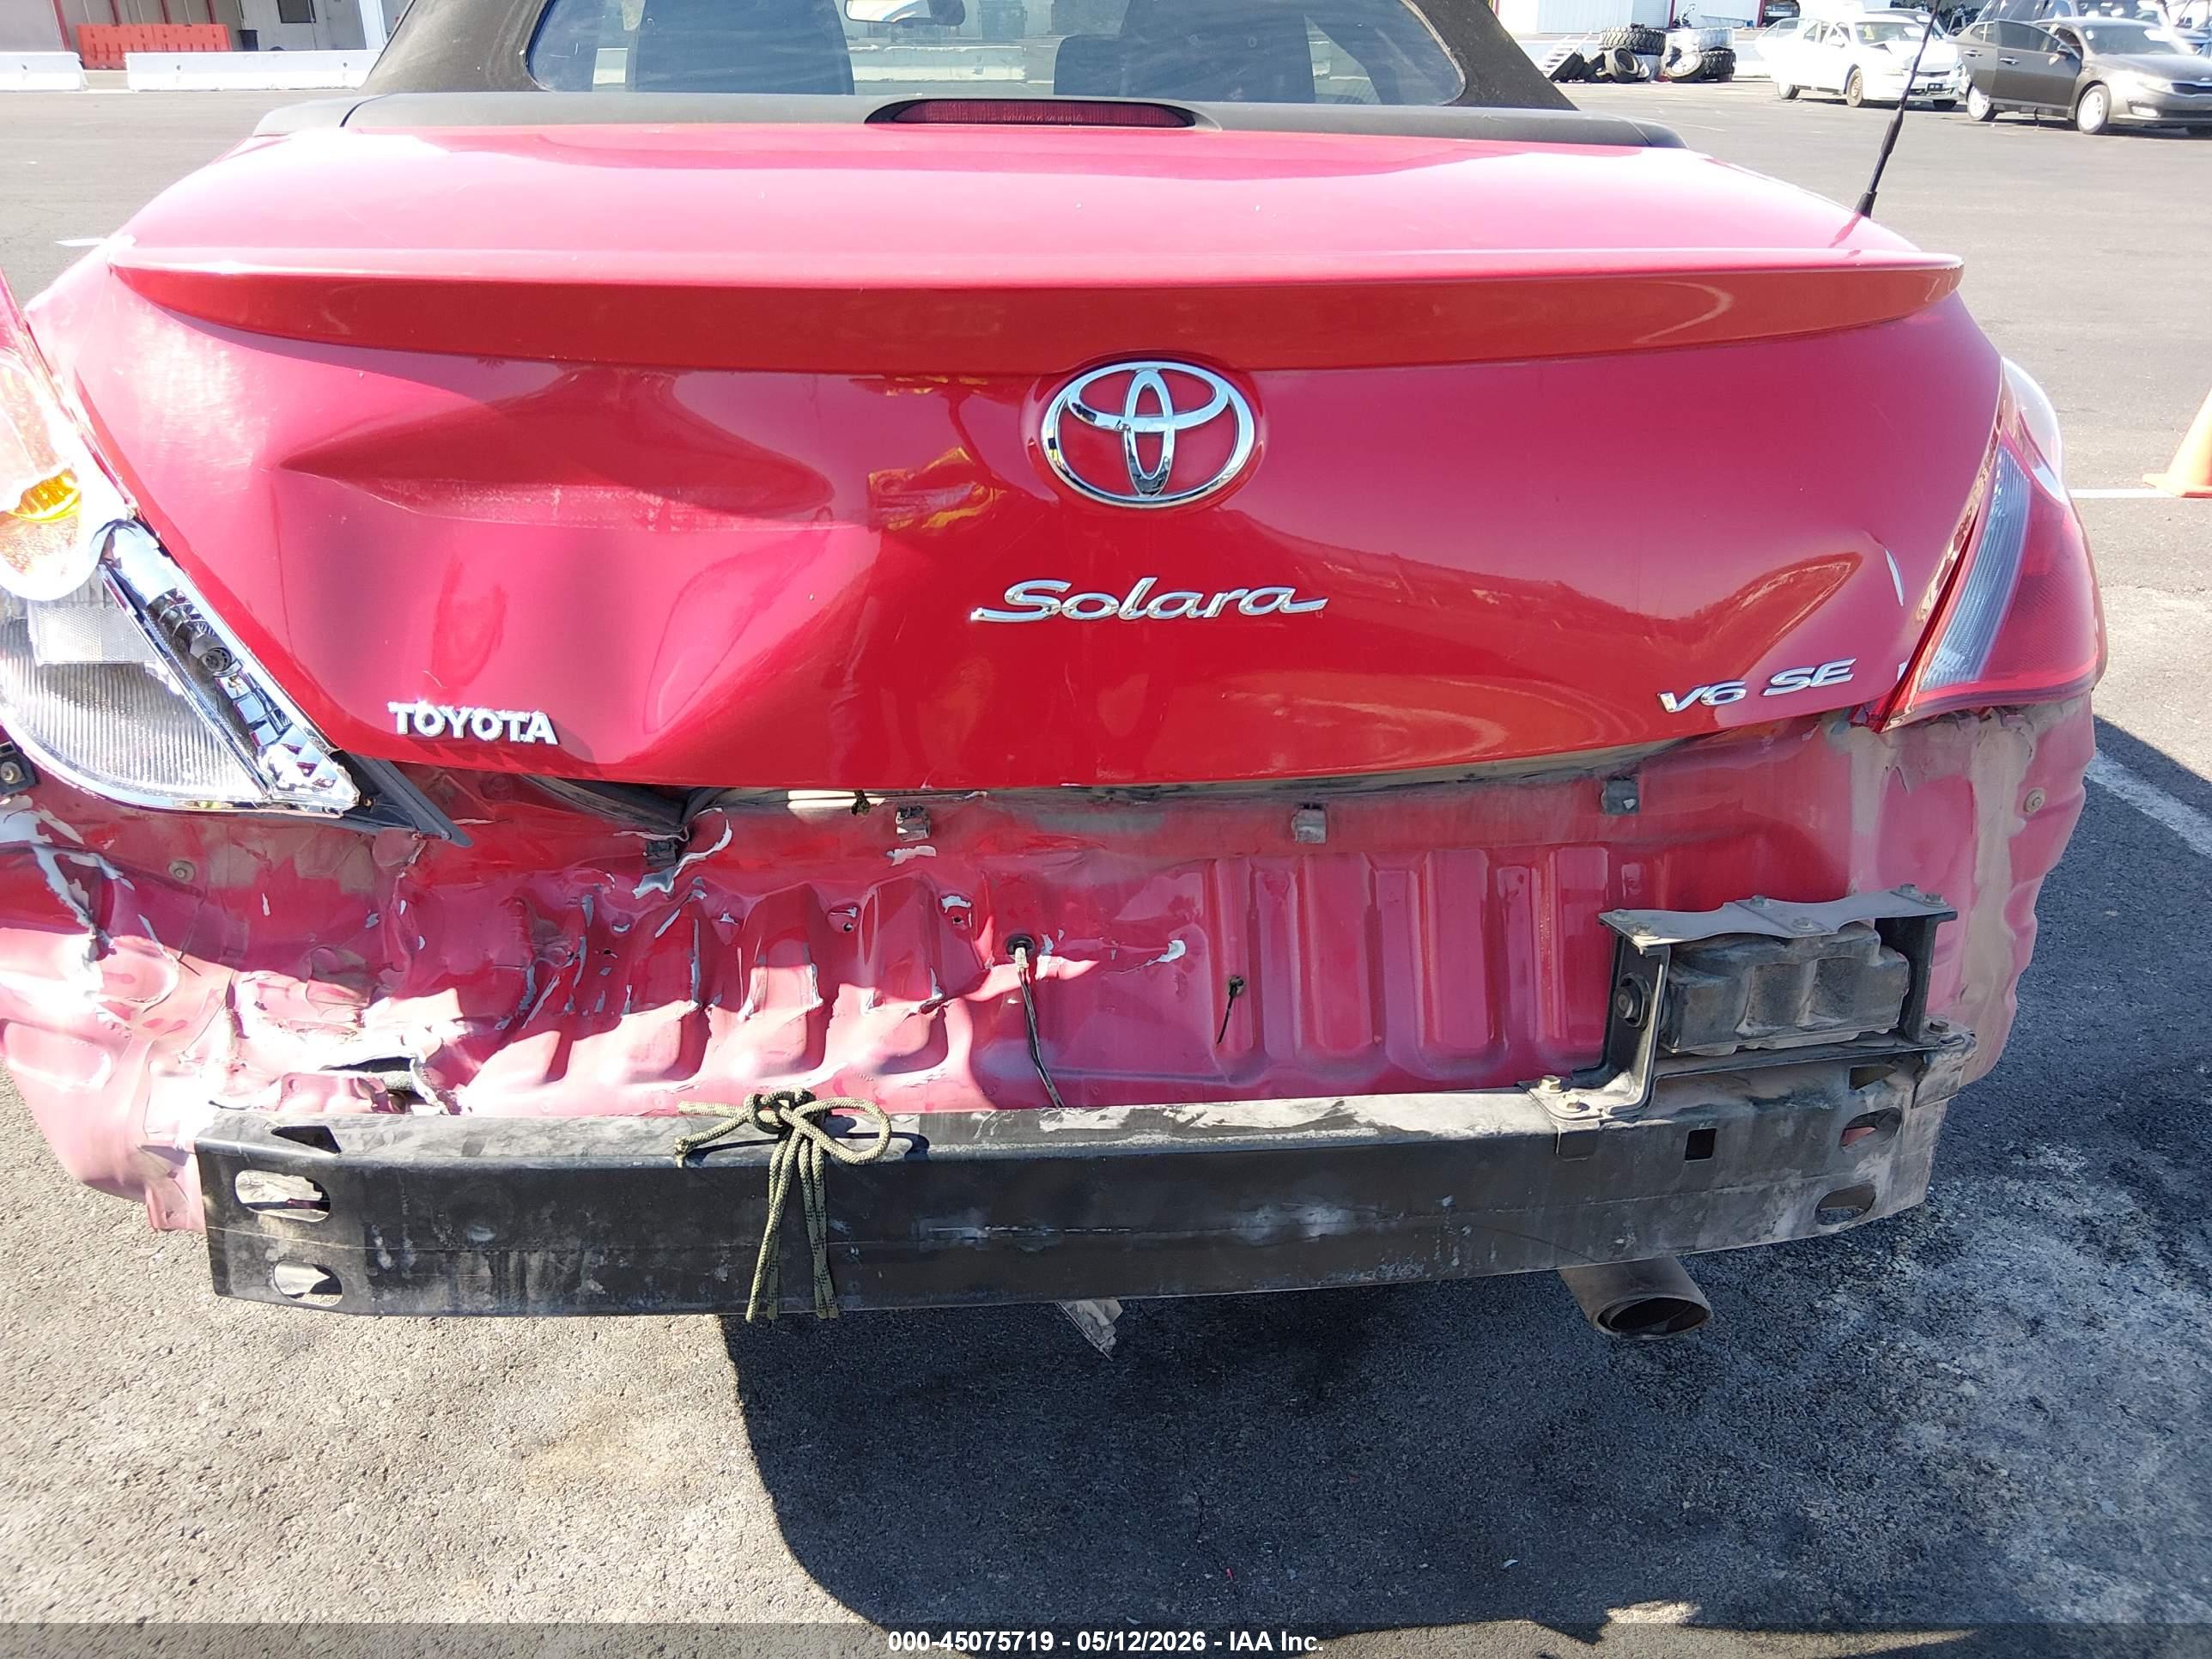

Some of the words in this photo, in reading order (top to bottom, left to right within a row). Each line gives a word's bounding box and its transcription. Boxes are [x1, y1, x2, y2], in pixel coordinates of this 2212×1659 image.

[970, 577, 1328, 623] Solara
[1656, 680, 1747, 714] V6
[1760, 658, 1857, 696] SE
[387, 700, 558, 745] TOYOTA
